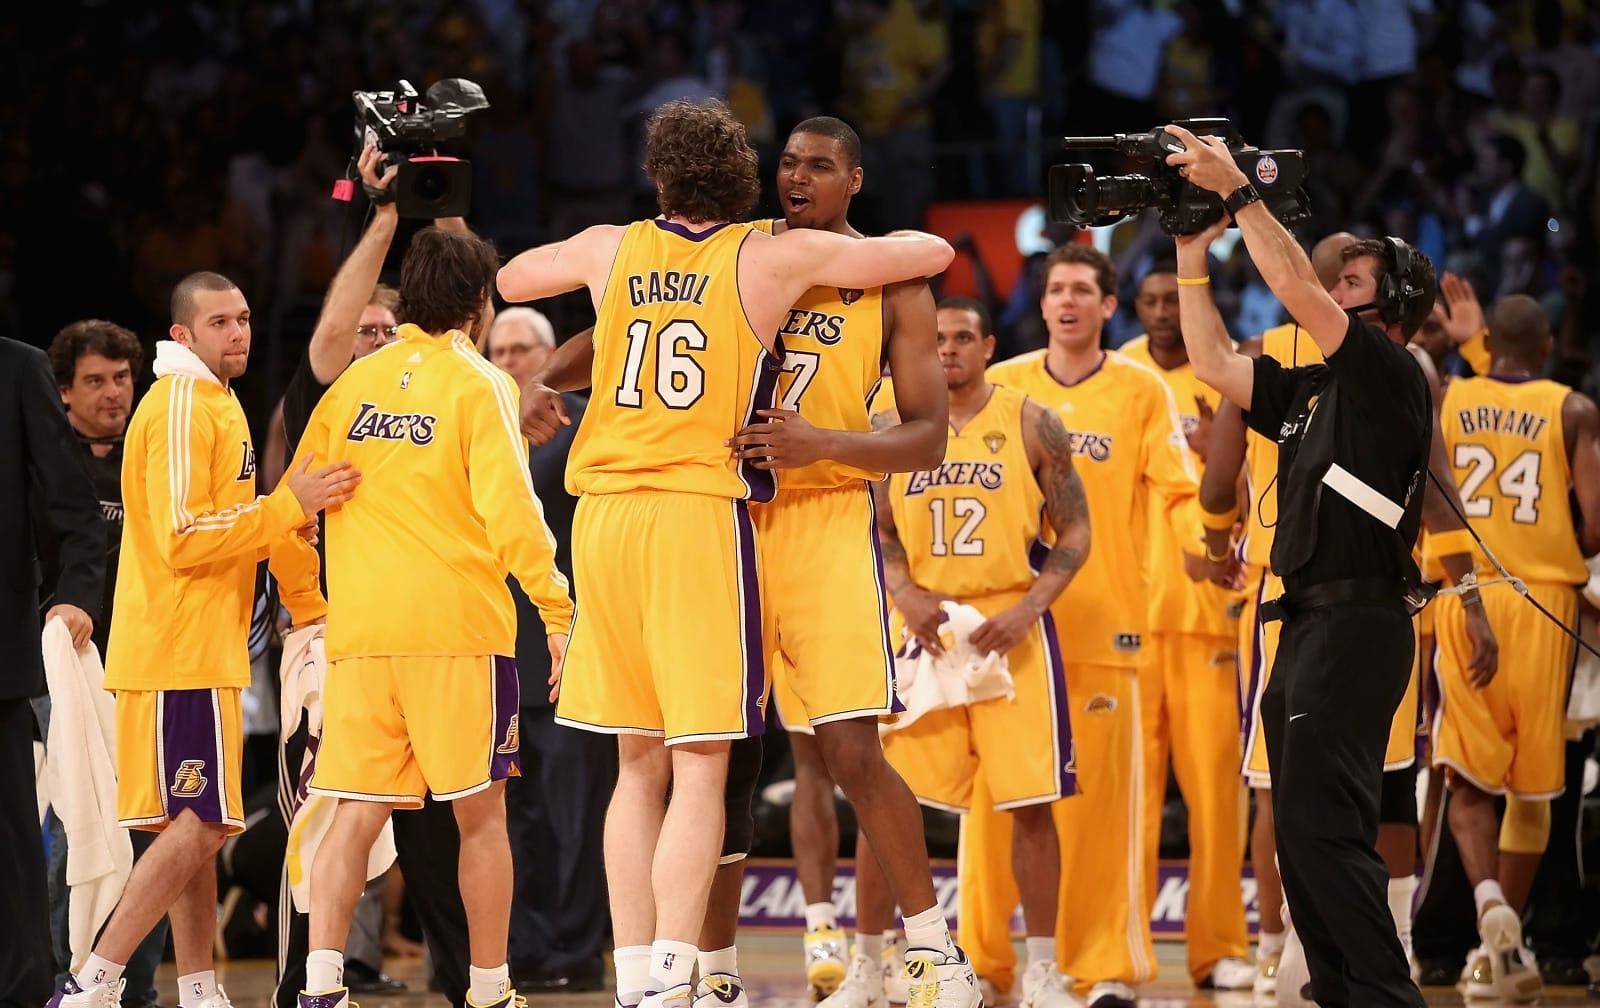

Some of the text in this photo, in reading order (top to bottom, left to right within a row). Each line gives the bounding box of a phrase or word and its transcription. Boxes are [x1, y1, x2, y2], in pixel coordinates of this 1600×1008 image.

[628, 271, 710, 307] GASOL
[779, 308, 846, 346] ERS
[615, 318, 708, 410] 16
[780, 349, 820, 414] 7
[346, 402, 437, 447] LAKERS
[1459, 405, 1547, 441] BRYANT
[1068, 432, 1113, 463] ERS
[905, 461, 1004, 497] LAKERS
[1454, 443, 1542, 525] 24
[929, 497, 987, 557] 12
